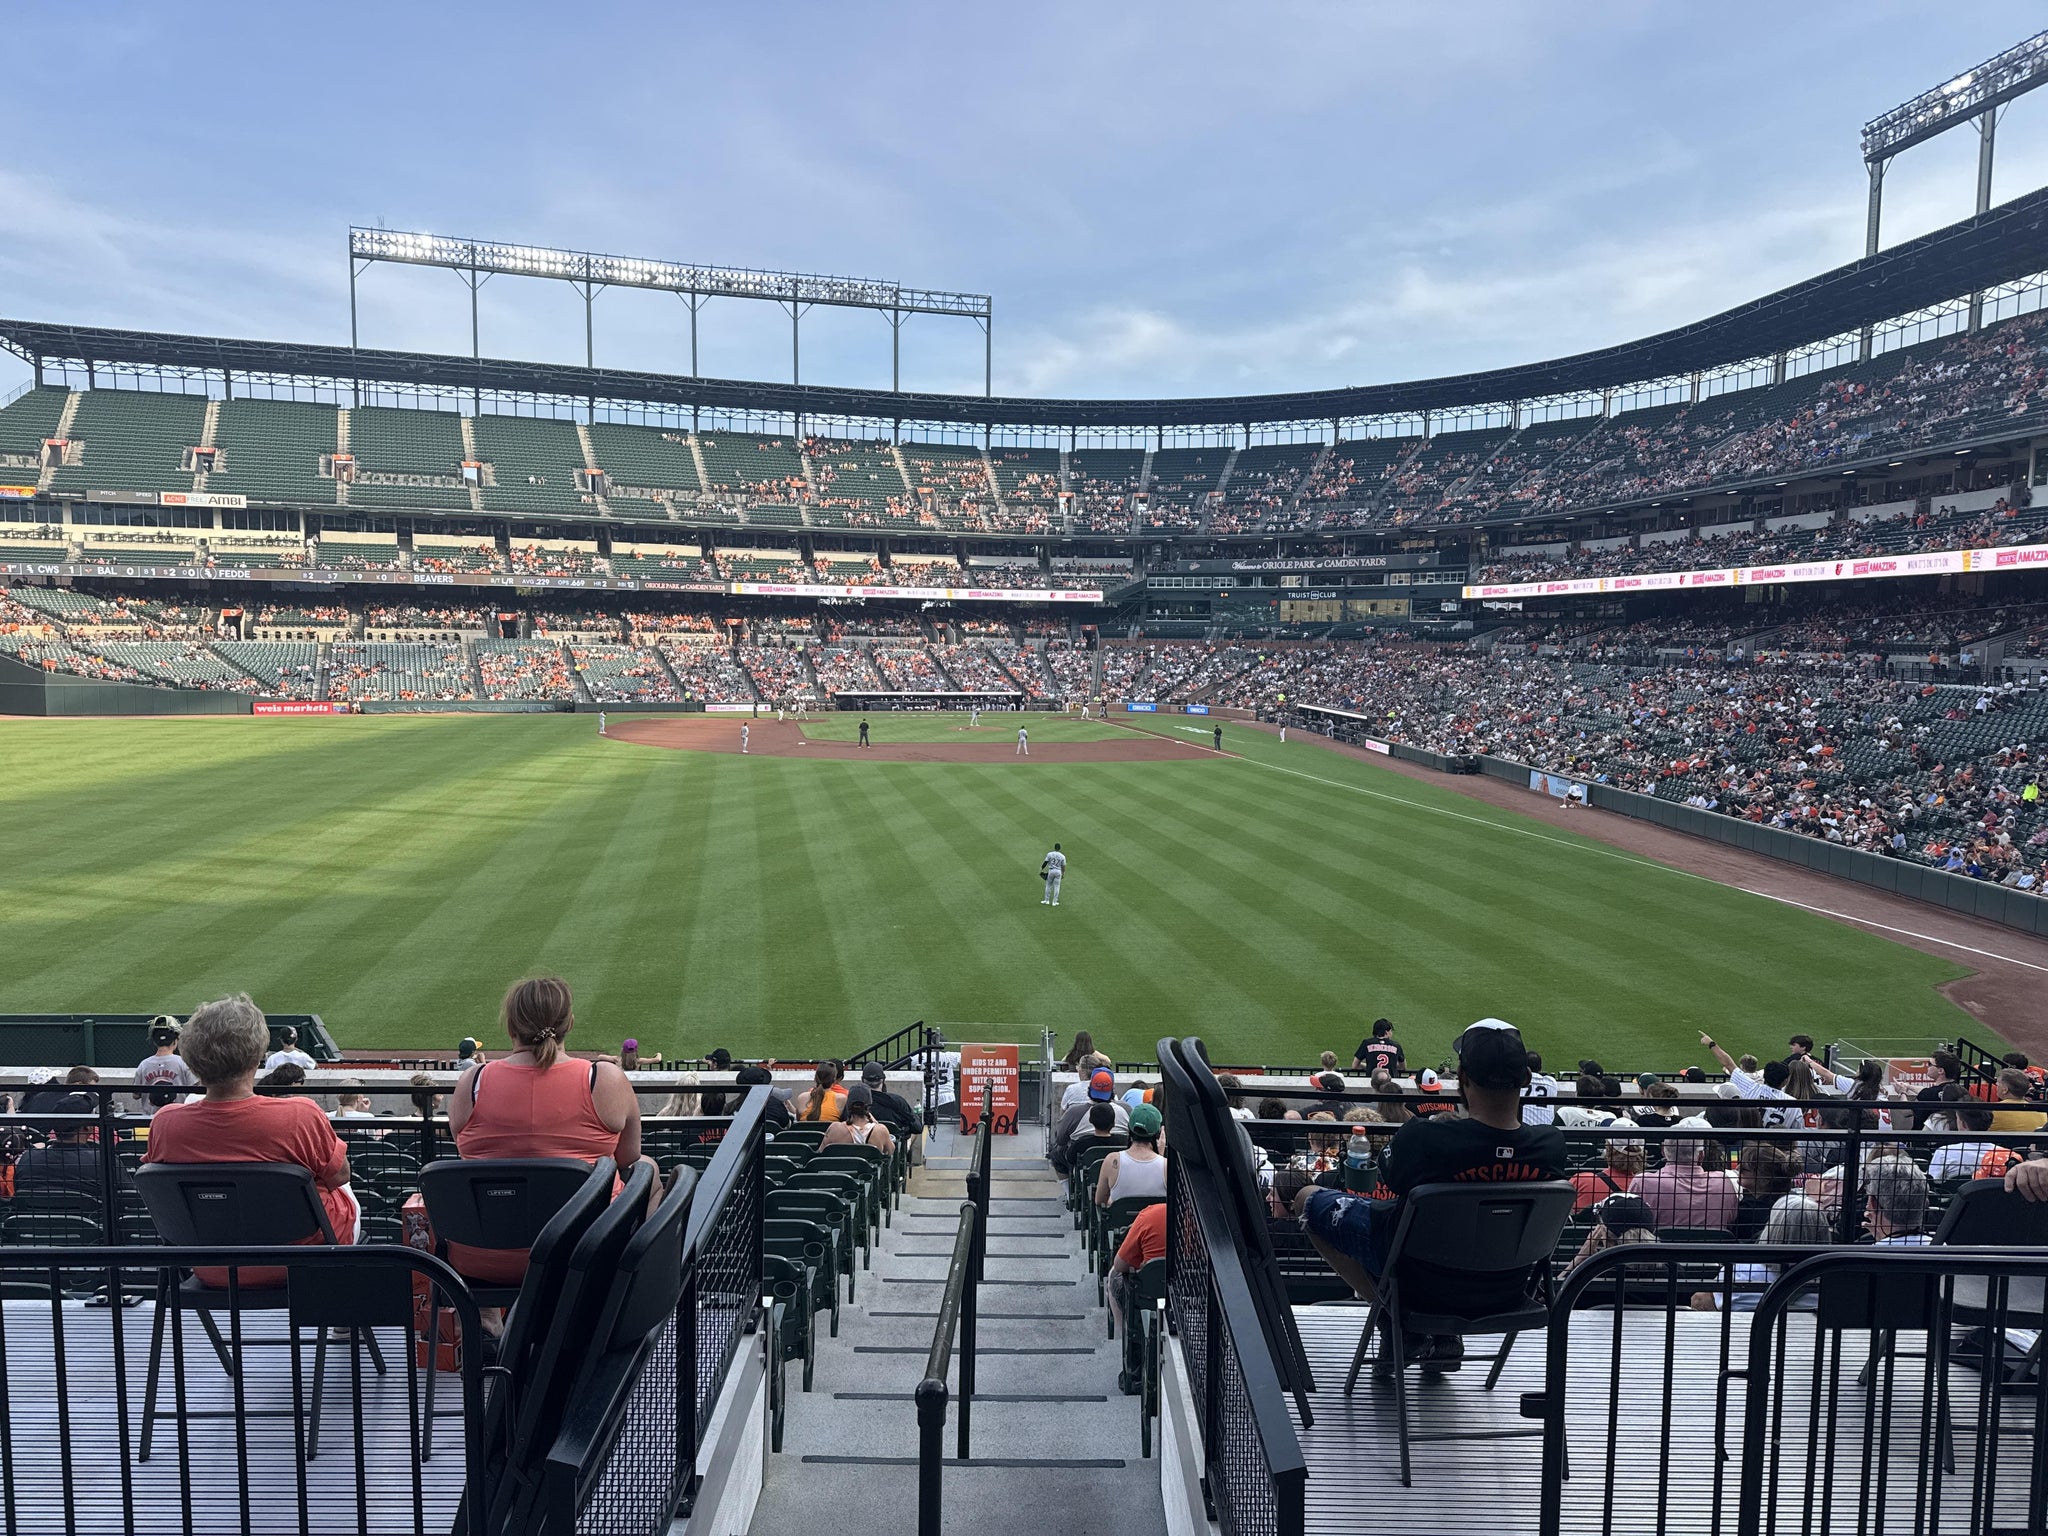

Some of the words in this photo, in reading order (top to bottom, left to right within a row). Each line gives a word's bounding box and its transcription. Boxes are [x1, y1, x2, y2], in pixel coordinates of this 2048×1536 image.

[1262, 561, 1293, 569] ORIOLE
[1293, 560, 1316, 569] PARK
[1323, 558, 1360, 568] CAMDEN
[1360, 557, 1387, 567] YARDS
[1869, 561, 1897, 572] AMAZING
[38, 565, 60, 574] CWS
[68, 566, 75, 574] 1
[97, 566, 118, 575] BAL
[126, 567, 134, 576] 0
[150, 567, 156, 576] 1
[169, 568, 176, 577] 2
[188, 569, 196, 577] 0
[218, 569, 251, 579] FEDDE
[308, 572, 314, 580] 2
[357, 573, 363, 581] 9
[413, 574, 454, 583] BEAVERS
[501, 577, 514, 586] L/R
[535, 578, 550, 586] .229
[601, 580, 608, 588] 2
[627, 580, 635, 588] 12
[686, 583, 708, 591] CAMDEN
[256, 704, 282, 712] weis
[283, 704, 328, 712] markets
[972, 1058, 987, 1066] KIDS
[987, 1058, 994, 1066] 12
[995, 1058, 1008, 1066] AND
[1376, 1053, 1389, 1072] 2
[962, 1067, 982, 1075] UNDER
[982, 1067, 1017, 1075] PERMITTED
[1915, 1072, 1922, 1081] 12
[968, 1085, 1011, 1093] SUPEISION.
